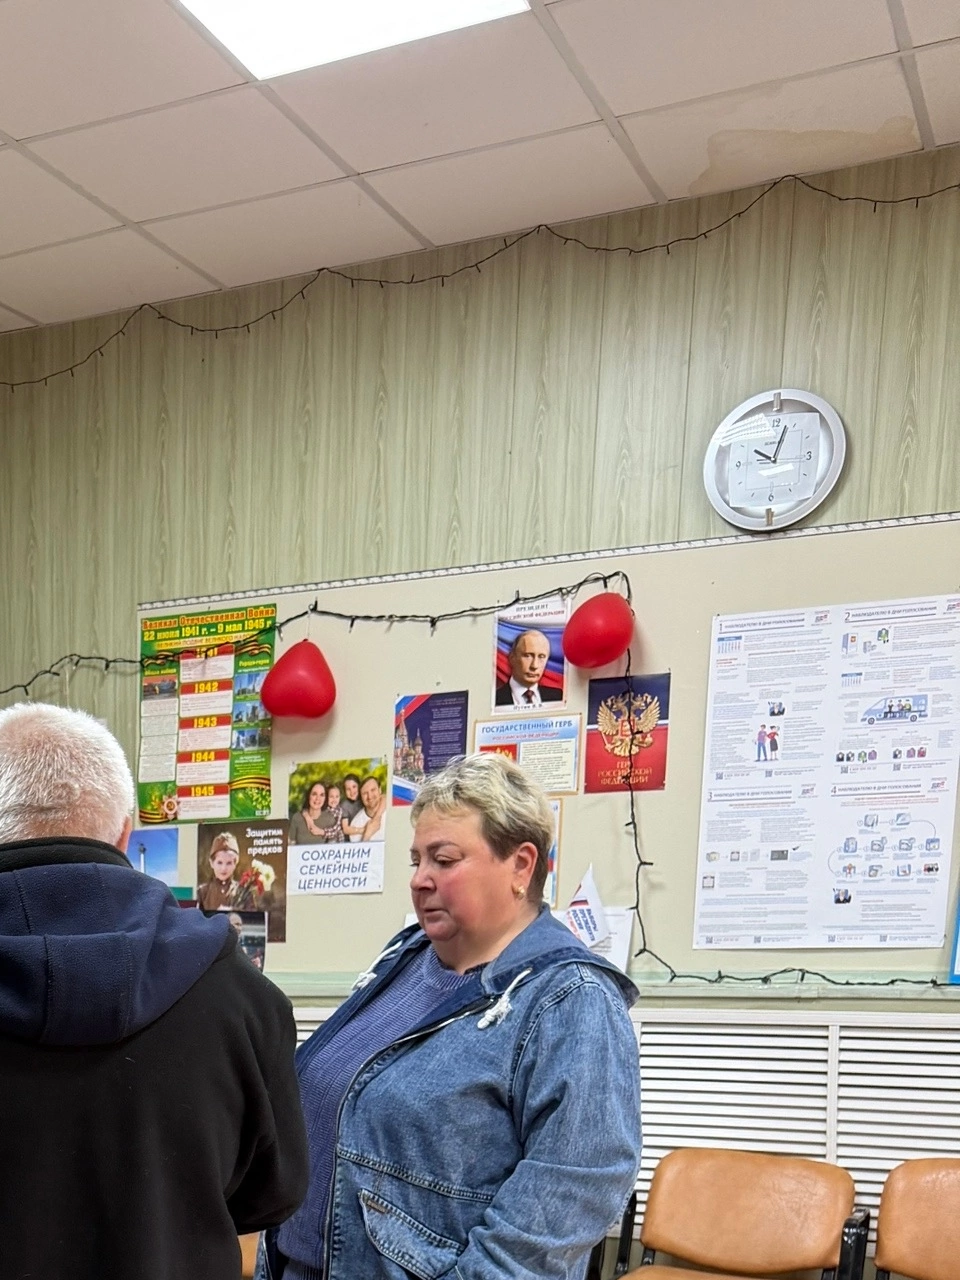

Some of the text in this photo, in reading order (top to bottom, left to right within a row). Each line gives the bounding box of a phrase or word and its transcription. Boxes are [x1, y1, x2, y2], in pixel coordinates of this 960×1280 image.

[771, 417, 781, 428] 12
[806, 450, 812, 460] 3
[735, 460, 741, 469] 9
[768, 492, 774, 502] 6
[142, 606, 276, 630] Великая Отечественная Война
[845, 611, 851, 621] 2
[143, 631, 155, 641] 22
[157, 630, 180, 640] июня
[181, 625, 199, 637] 1941
[217, 622, 224, 633] 9
[225, 623, 242, 632] мая
[244, 619, 264, 631] 1945
[194, 682, 219, 693] 1942
[193, 717, 217, 728] 1943
[481, 720, 573, 733] ГОСУДАРСТВЕННЫЙ ГЕРБ
[191, 751, 215, 762] 1944
[616, 761, 633, 769] ГЕР
[191, 785, 214, 797] 1945
[708, 791, 713, 800] 3
[831, 786, 837, 794] 4
[245, 828, 284, 838] Защитим
[253, 838, 283, 846] память
[247, 847, 283, 857] предков
[301, 848, 371, 861] СОХРАНИМ
[299, 860, 369, 876] СЕМЕЙНЫЕ
[297, 876, 367, 891] ЦЕННОСТИ
